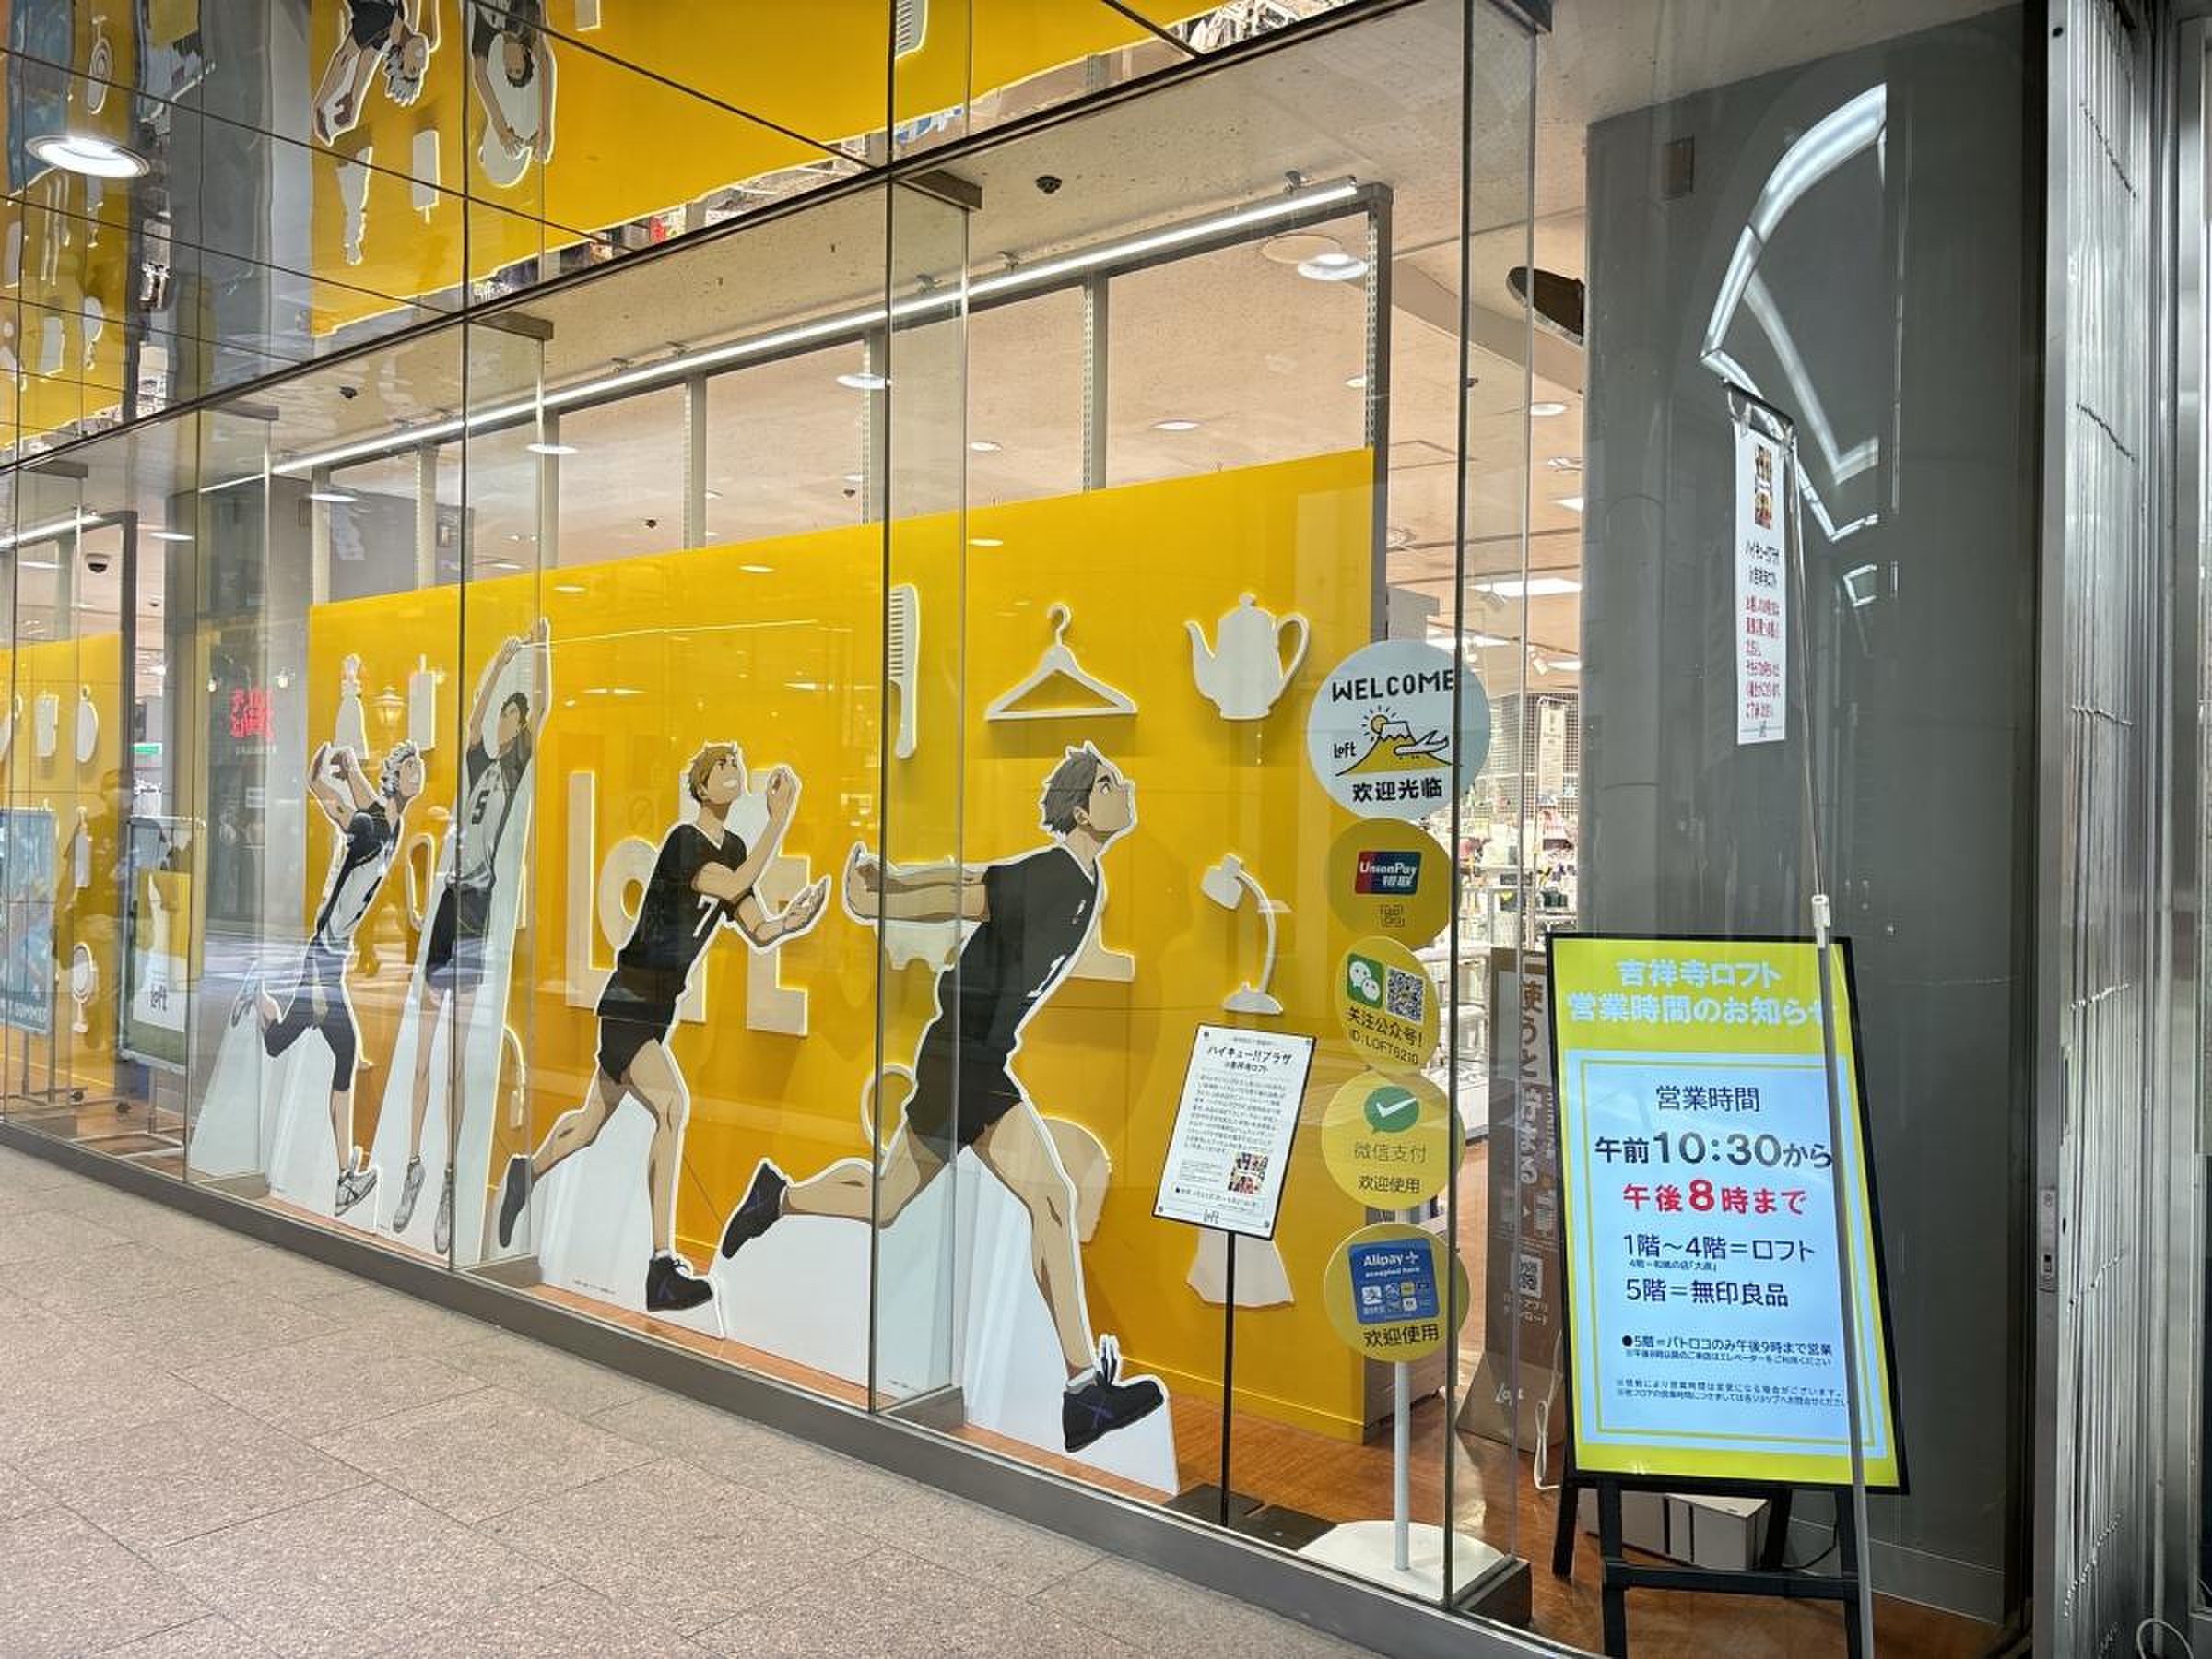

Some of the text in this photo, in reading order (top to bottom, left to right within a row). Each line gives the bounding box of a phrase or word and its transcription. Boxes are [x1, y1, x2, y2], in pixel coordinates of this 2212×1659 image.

[1332, 669, 1453, 702] WELCOME
[1352, 777, 1442, 803] 欢迎光临
[472, 789, 490, 826] 5
[1359, 861, 1417, 879] UnionPay
[696, 896, 719, 938] 7
[1617, 958, 1783, 989] 吉祥寺ロフト
[1656, 1086, 1760, 1112] 営業時間
[1355, 1142, 1426, 1163] 微信支付
[1594, 1132, 1833, 1169] 午前10:30から
[1358, 1175, 1420, 1194] 欢迎使用
[1623, 1179, 1807, 1216] 午後8時まで
[1625, 1278, 1789, 1308] 5階＝無印良品
[1362, 1324, 1439, 1347] 欢迎使用
